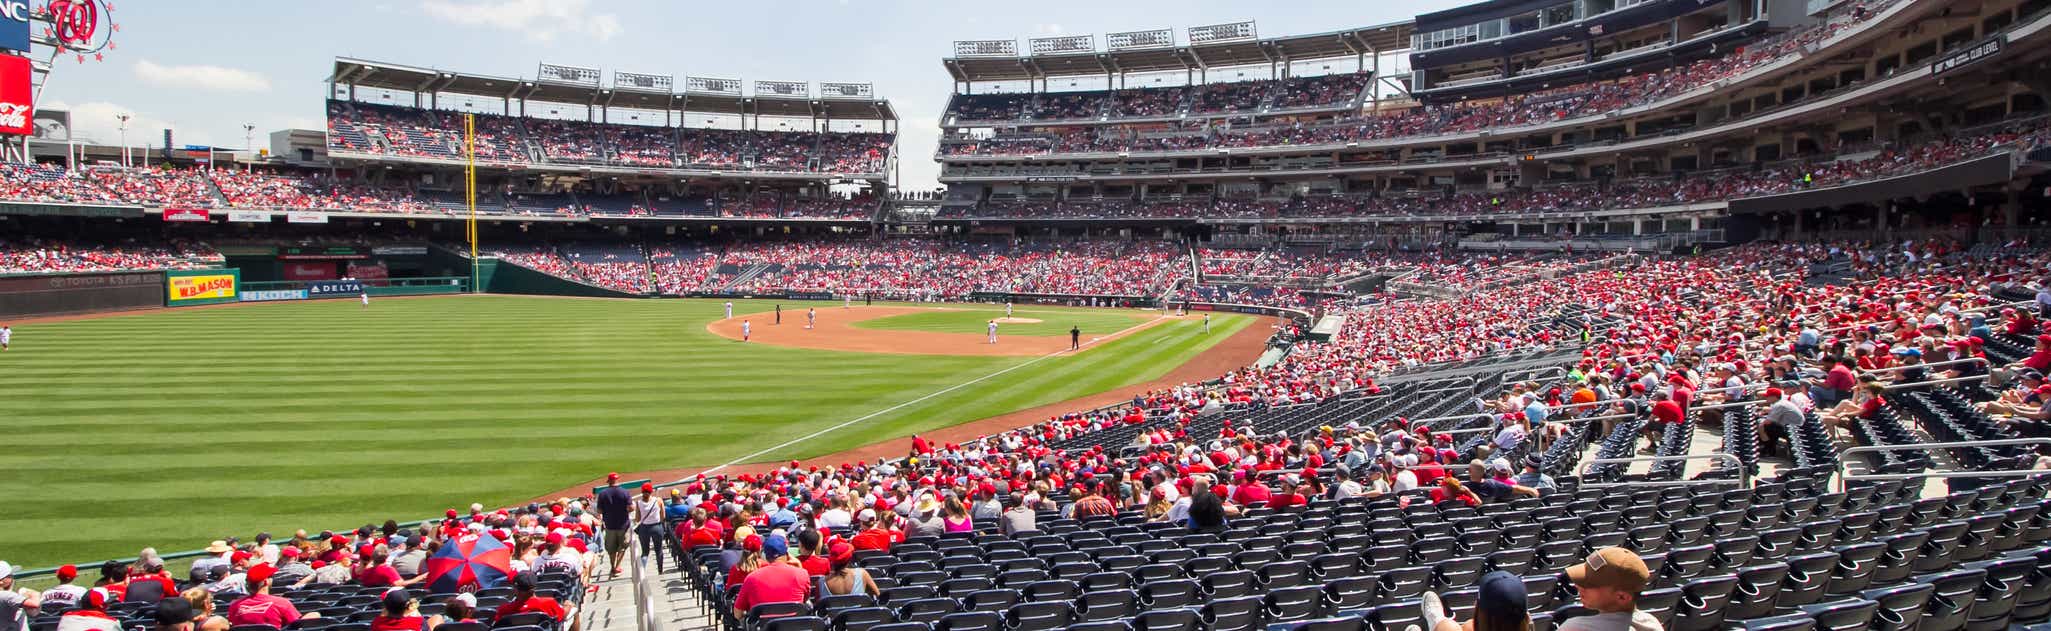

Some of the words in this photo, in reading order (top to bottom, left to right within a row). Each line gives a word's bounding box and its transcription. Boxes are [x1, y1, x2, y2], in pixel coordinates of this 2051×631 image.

[1983, 41, 1999, 55] LEVEL
[67, 276, 104, 286] TOYOTA
[323, 284, 360, 292] DELTA
[45, 591, 74, 601] TURNER
